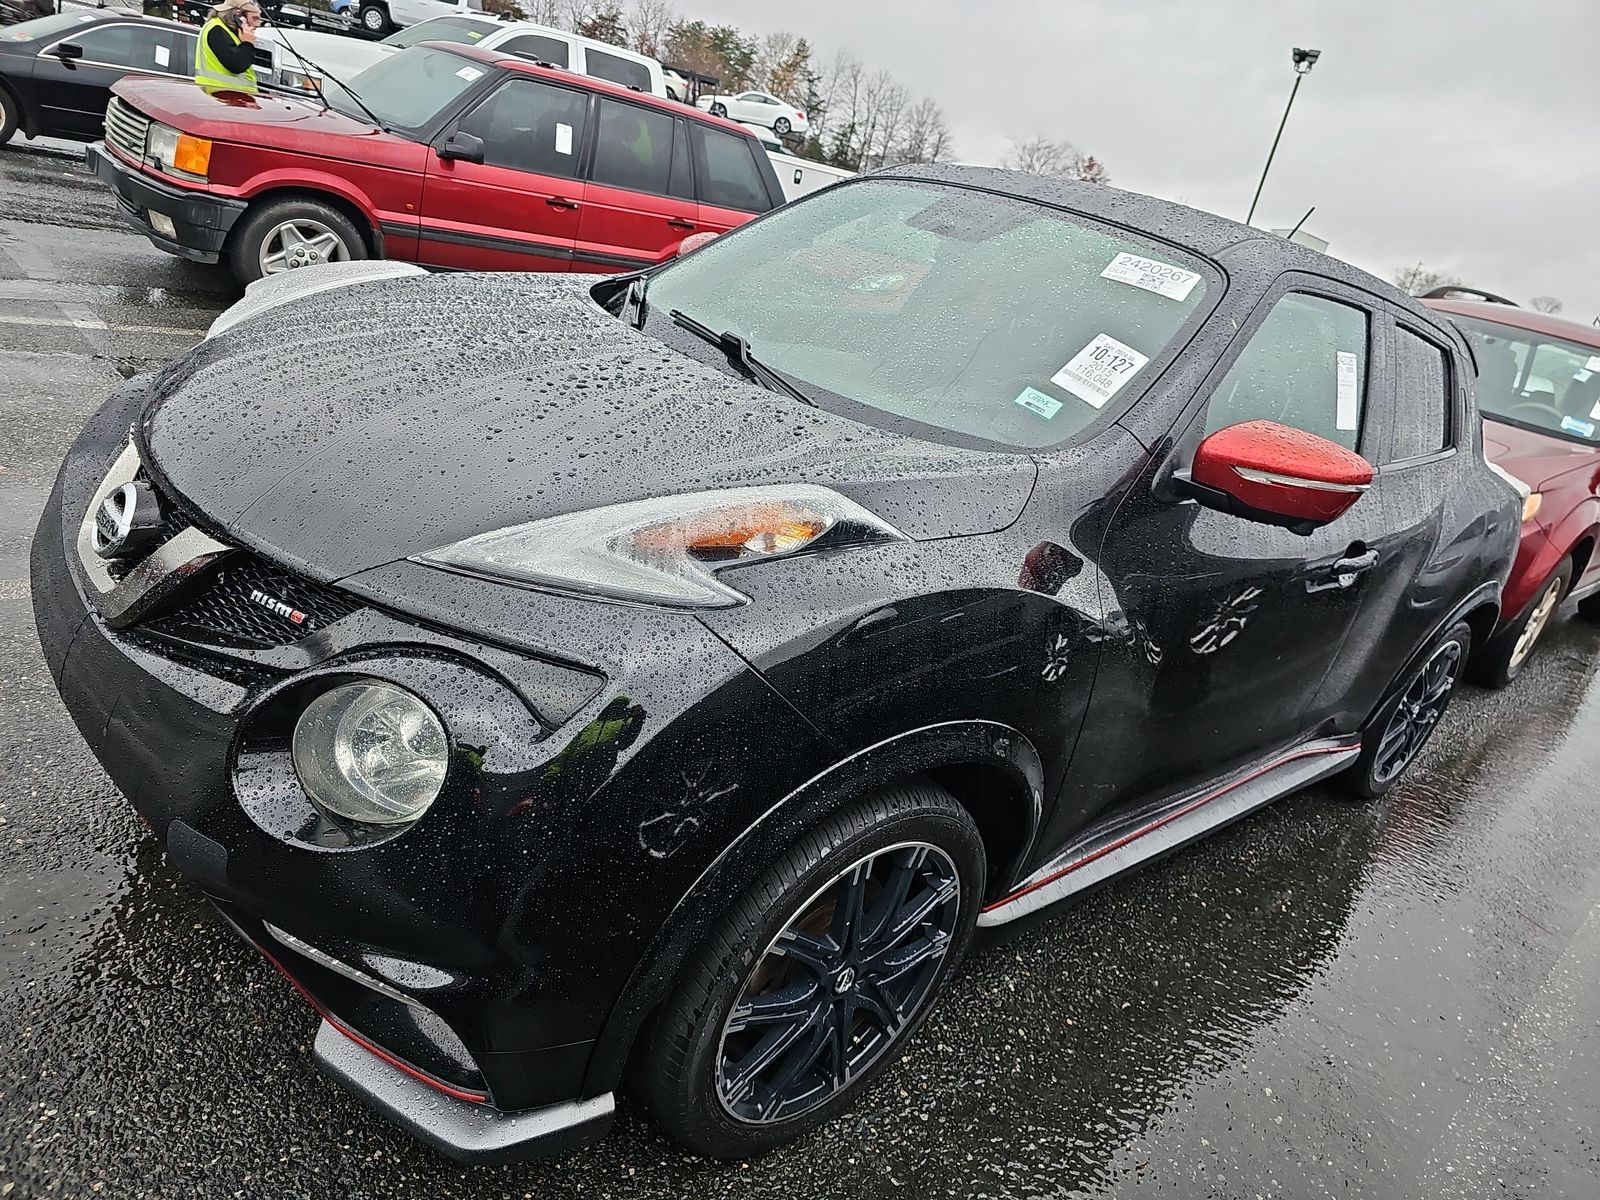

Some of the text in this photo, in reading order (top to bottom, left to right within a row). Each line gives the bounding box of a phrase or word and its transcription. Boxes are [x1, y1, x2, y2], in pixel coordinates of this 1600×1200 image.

[1119, 256, 1195, 284] 2420267
[1089, 345, 1135, 374] 10:127
[1089, 360, 1116, 378] 2015
[1076, 364, 1113, 389] 116,048
